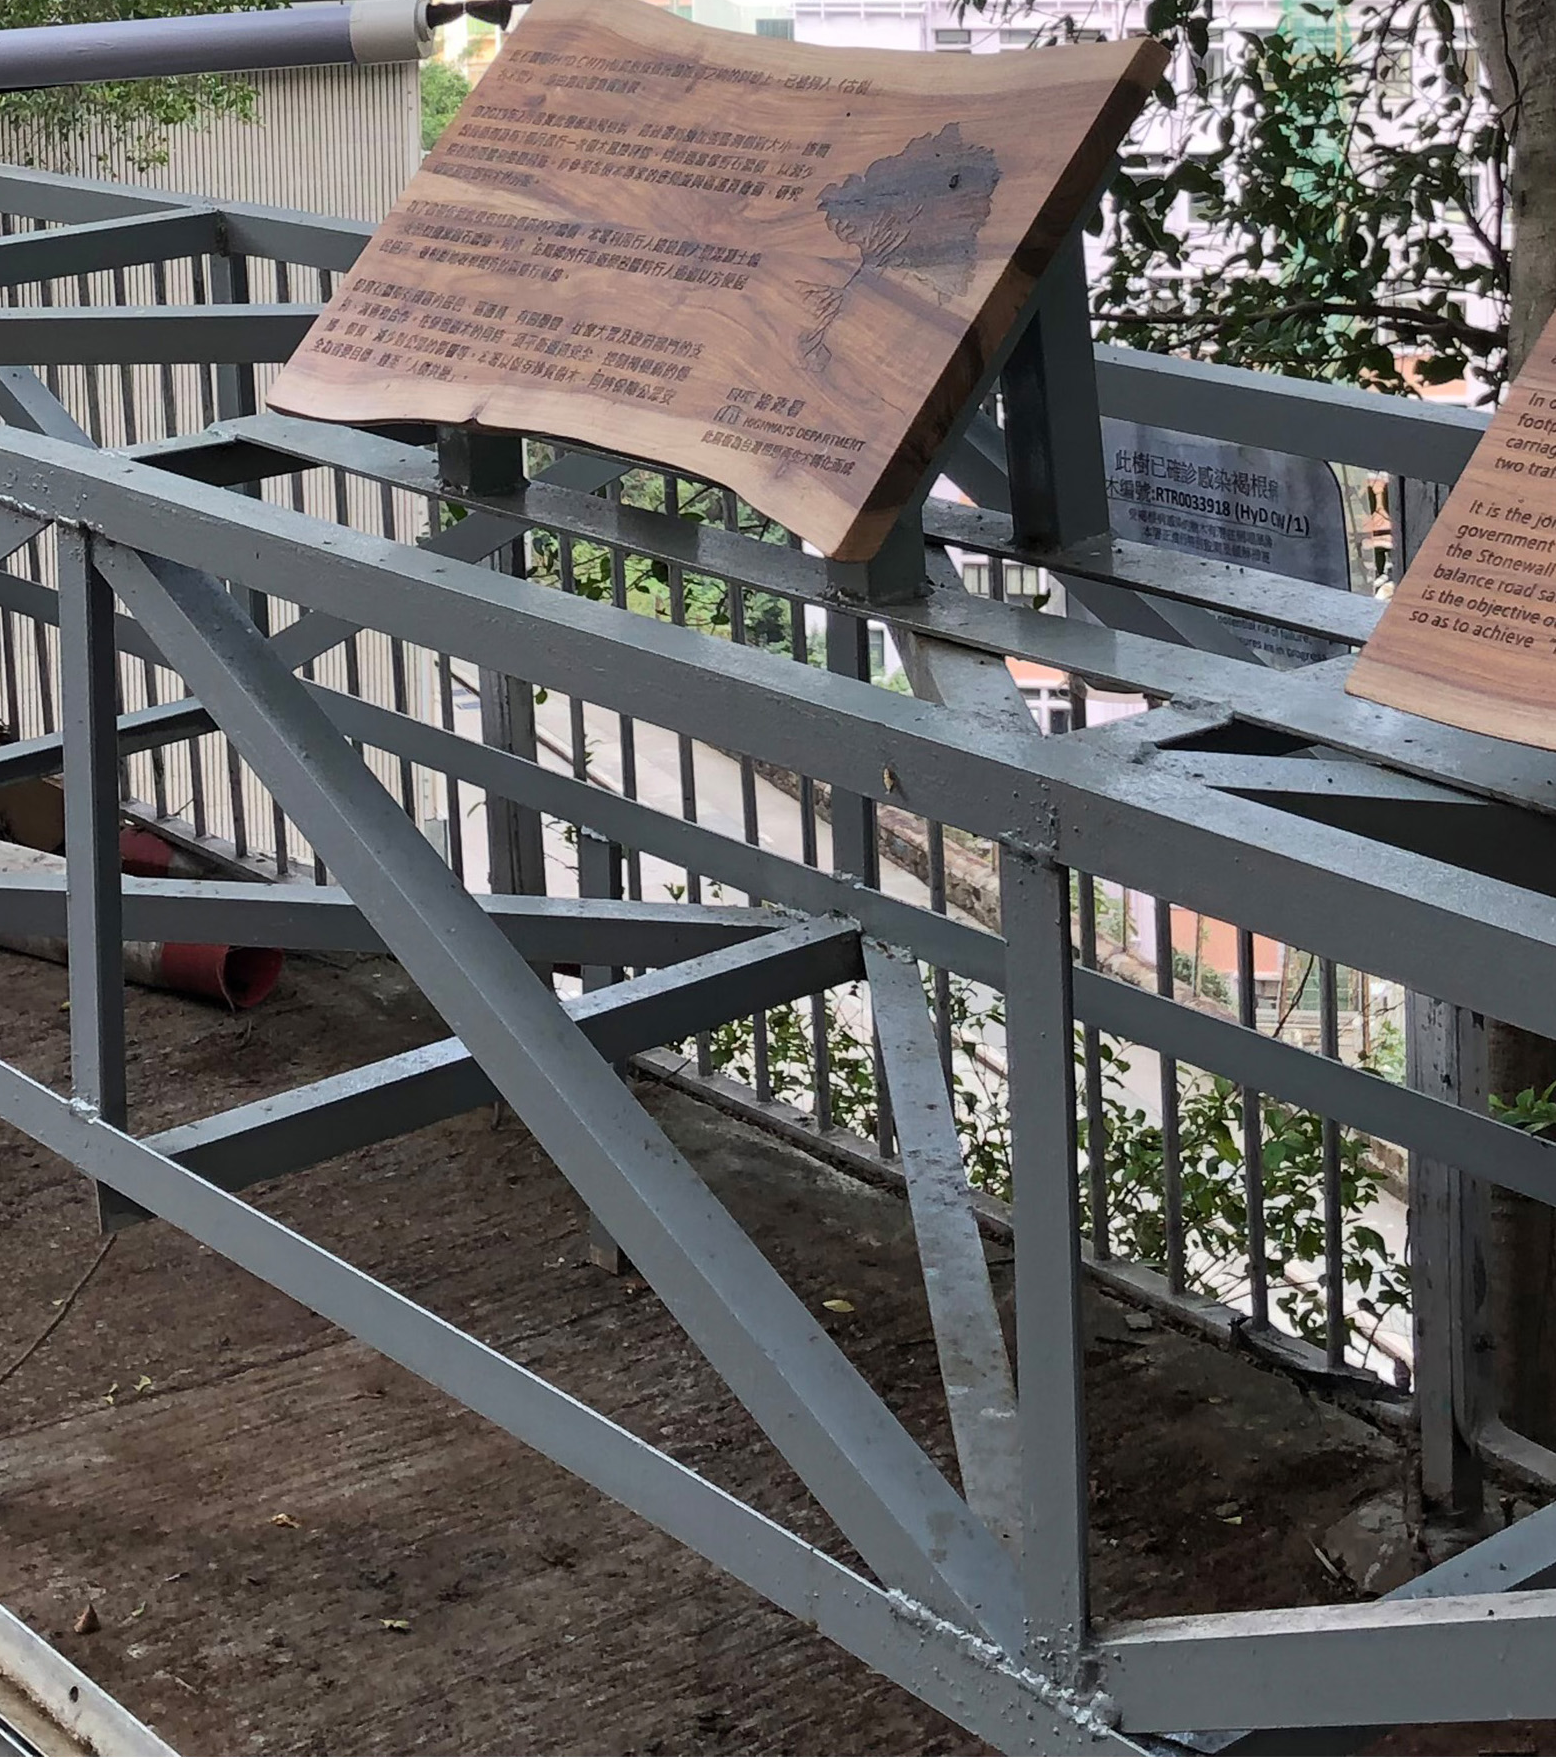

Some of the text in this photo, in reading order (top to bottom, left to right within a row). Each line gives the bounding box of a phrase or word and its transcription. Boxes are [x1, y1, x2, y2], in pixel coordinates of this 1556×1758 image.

[743, 417, 866, 452] HIGHWAYS DEPARTMENT
[1492, 458, 1524, 472] two
[1235, 501, 1268, 526] (HyD
[1468, 501, 1483, 514] It
[1485, 504, 1500, 517] is
[1503, 509, 1532, 523] the
[1455, 527, 1555, 552] government
[1408, 613, 1428, 624] so
[1430, 618, 1449, 629] as
[1451, 620, 1469, 633] to
[1472, 627, 1534, 647] achieve
